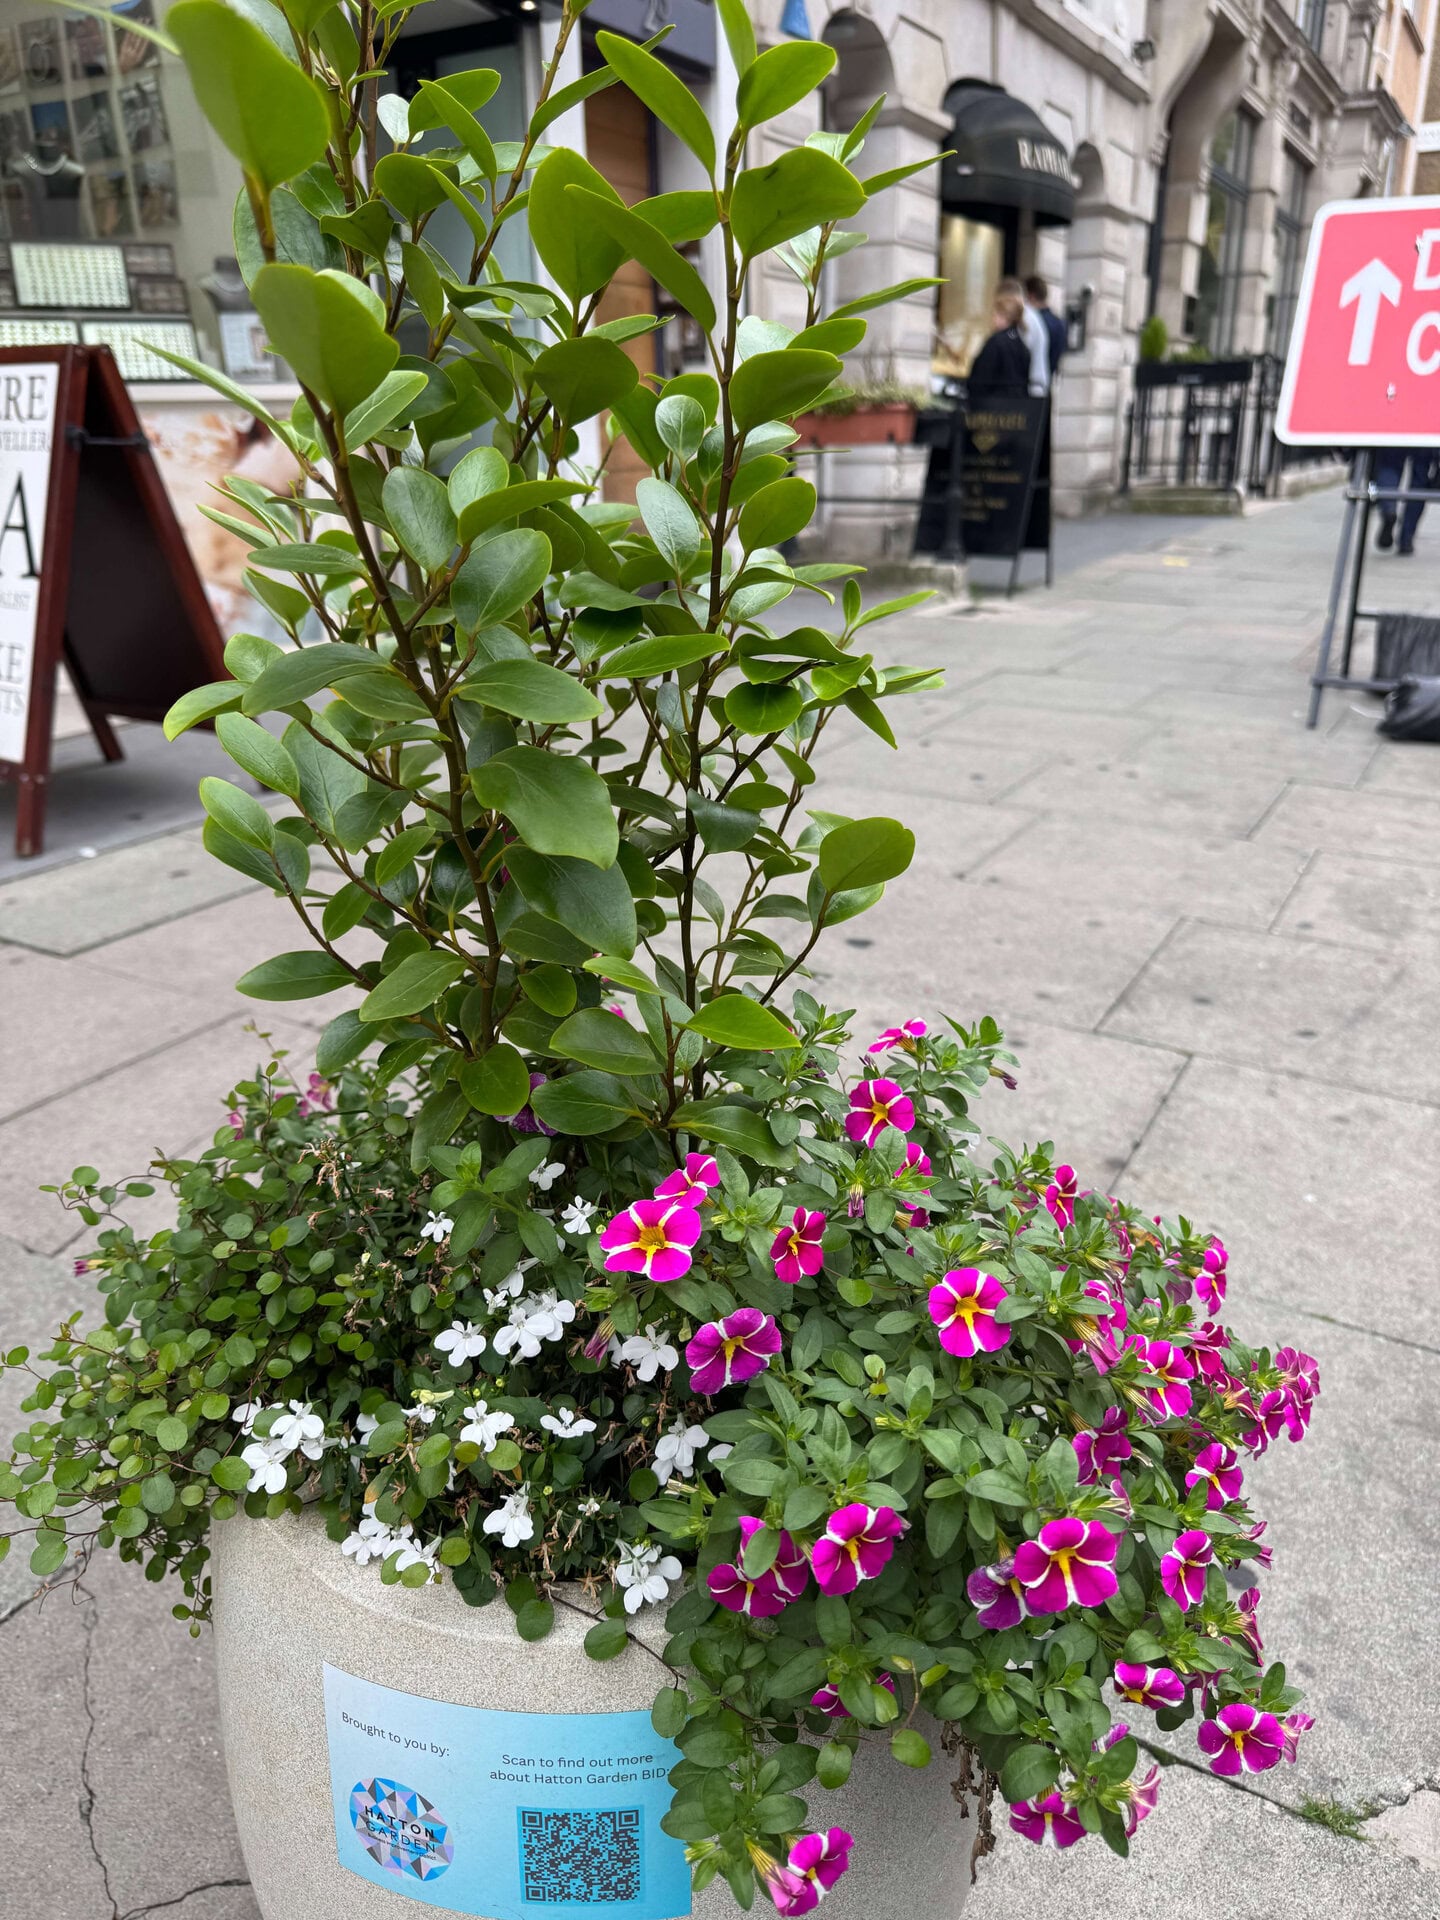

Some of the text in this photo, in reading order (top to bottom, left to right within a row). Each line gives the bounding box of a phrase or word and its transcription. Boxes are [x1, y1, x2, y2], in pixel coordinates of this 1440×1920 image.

[0, 376, 48, 423] RE
[342, 1711, 450, 1757] Brought to you by:
[489, 1770, 531, 1783] about
[534, 1773, 582, 1784] Hatton
[587, 1769, 637, 1784] Garden
[502, 1754, 653, 1768] Scan to find out more
[364, 1805, 435, 1839] HATTON
[365, 1821, 436, 1853] GARDEN
